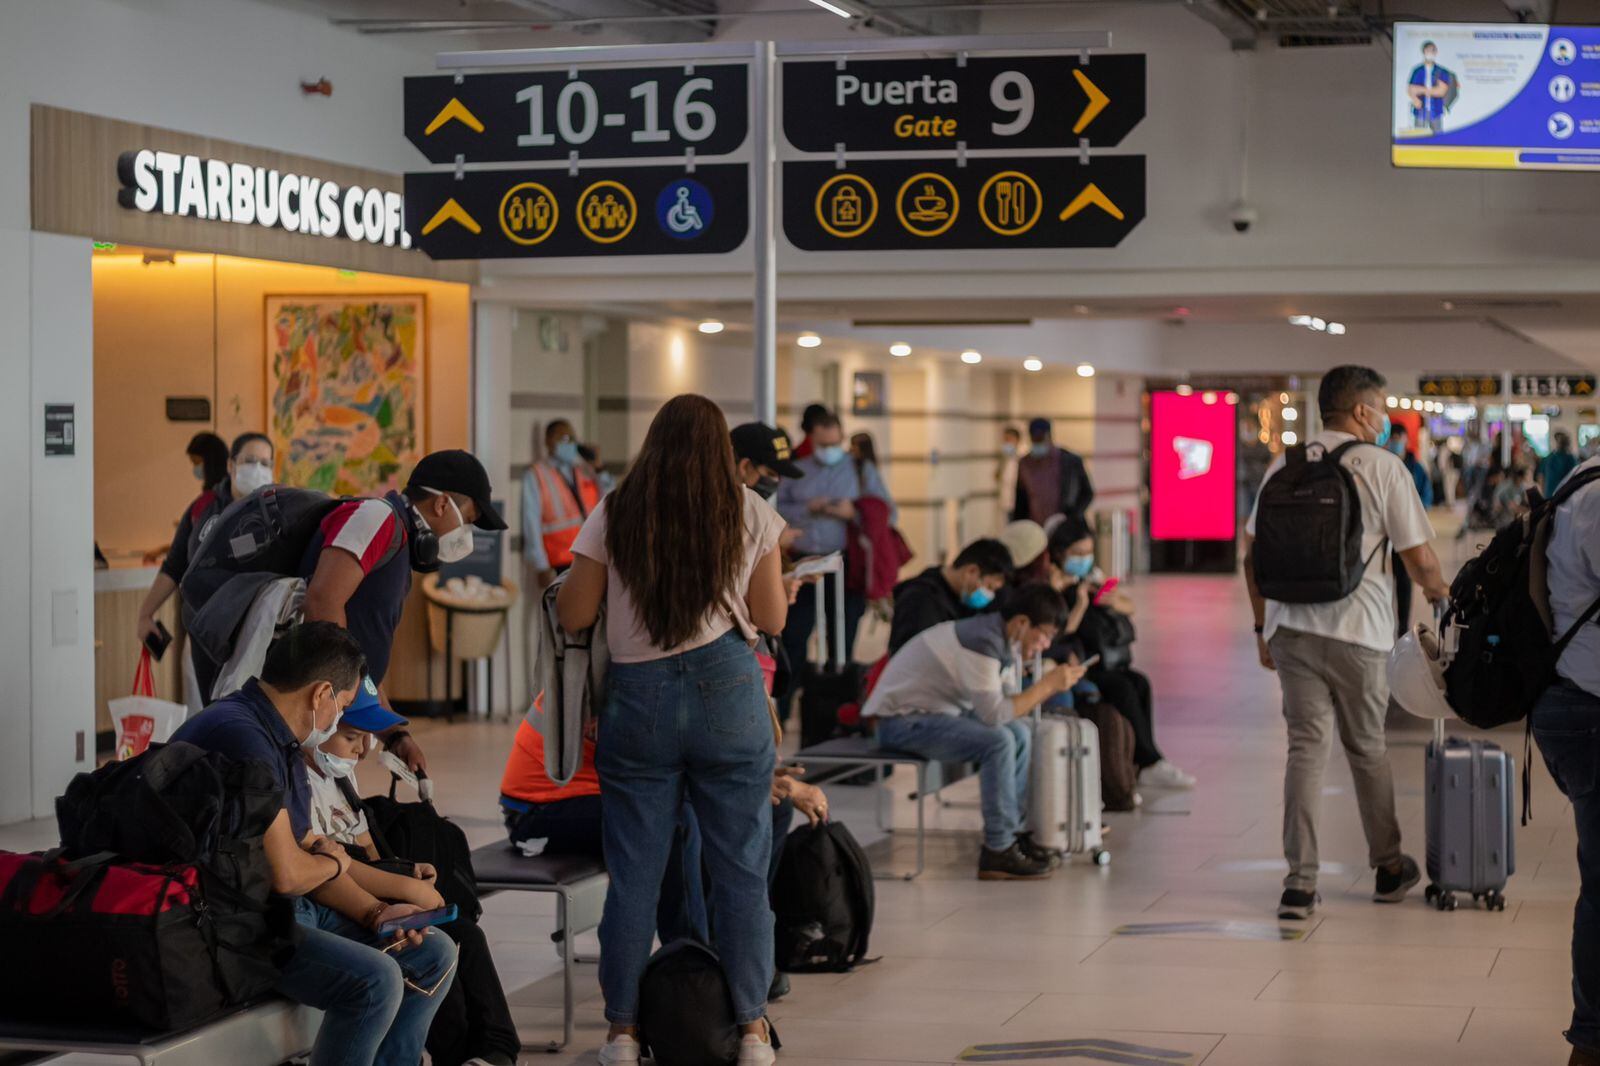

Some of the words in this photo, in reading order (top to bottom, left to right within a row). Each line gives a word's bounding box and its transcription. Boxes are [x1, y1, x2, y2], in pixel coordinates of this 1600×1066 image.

[514, 77, 717, 147] 10-16
[835, 74, 958, 106] Puerta
[988, 70, 1035, 136] 9
[893, 114, 957, 138] Gate
[134, 149, 341, 238] STARBUCKS
